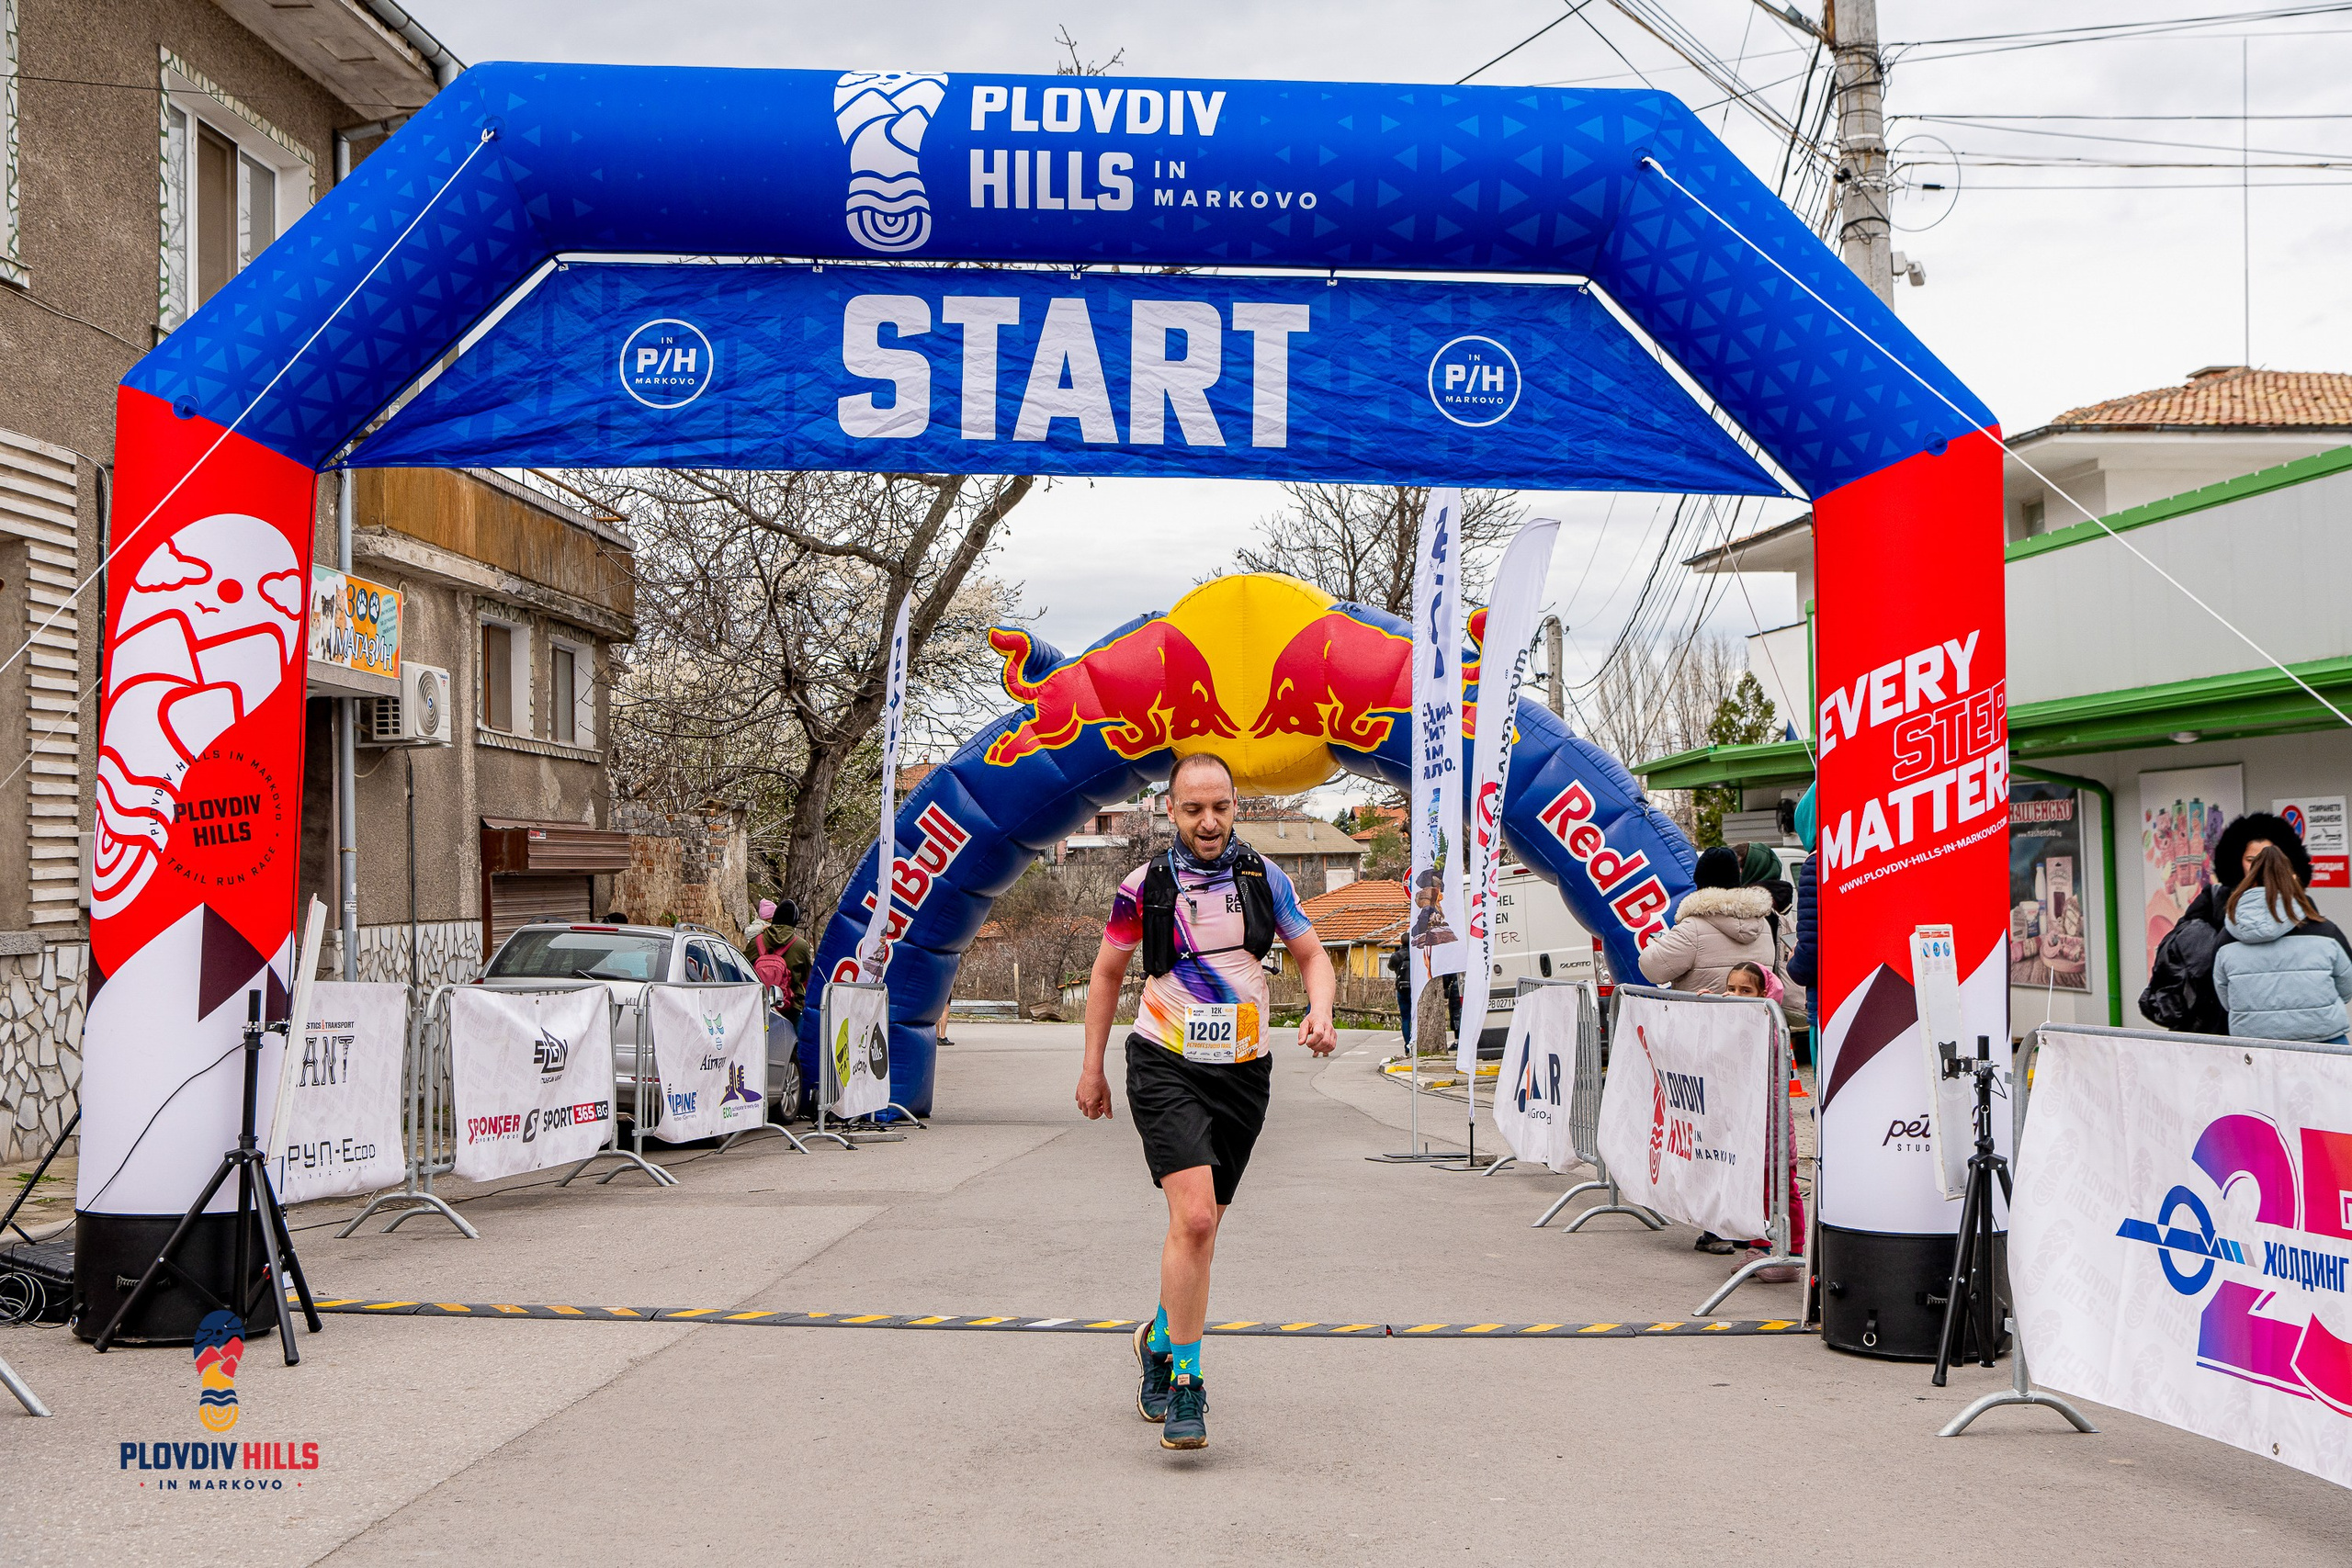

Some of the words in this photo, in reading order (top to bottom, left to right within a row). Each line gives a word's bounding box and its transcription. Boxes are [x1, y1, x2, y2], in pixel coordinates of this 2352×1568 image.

[971, 85, 1227, 137] PLOVDIV
[970, 149, 1134, 211] HILLS
[1154, 161, 1186, 179] IN
[1154, 188, 1318, 210] MARKOVO
[661, 336, 673, 344] IN
[637, 347, 697, 375] P/H
[837, 294, 1310, 447] START
[1445, 364, 1504, 394] P/H
[1445, 395, 1504, 405] MARKOVO
[334, 626, 394, 671] МАГАЗИН
[1819, 629, 1980, 761] EVERY
[1893, 678, 2007, 782] STEP
[150, 773, 172, 836] PLOVDIV
[175, 750, 220, 772] HILLS
[230, 750, 244, 762] IN
[250, 759, 282, 821] MARKOVO
[174, 795, 261, 824] PLOVDIV
[193, 821, 252, 847] HILLS
[1539, 783, 1648, 893] Red
[167, 857, 207, 885] TRAIL
[217, 874, 245, 886] RUN
[251, 846, 276, 876] RACE
[891, 803, 969, 908] Bull
[1497, 896, 1514, 906] HEL
[1495, 912, 1509, 924] EN
[305, 1021, 322, 1030] STICS
[325, 1021, 355, 1030] TRANSPORT
[1189, 1021, 1231, 1041] 1202
[296, 1035, 355, 1088] ANT
[468, 1114, 521, 1145] SPONSER
[1694, 1130, 1702, 1143] IN
[1897, 1143, 1930, 1152] STUD
[2263, 1240, 2350, 1293] ХОЛДИНГ
